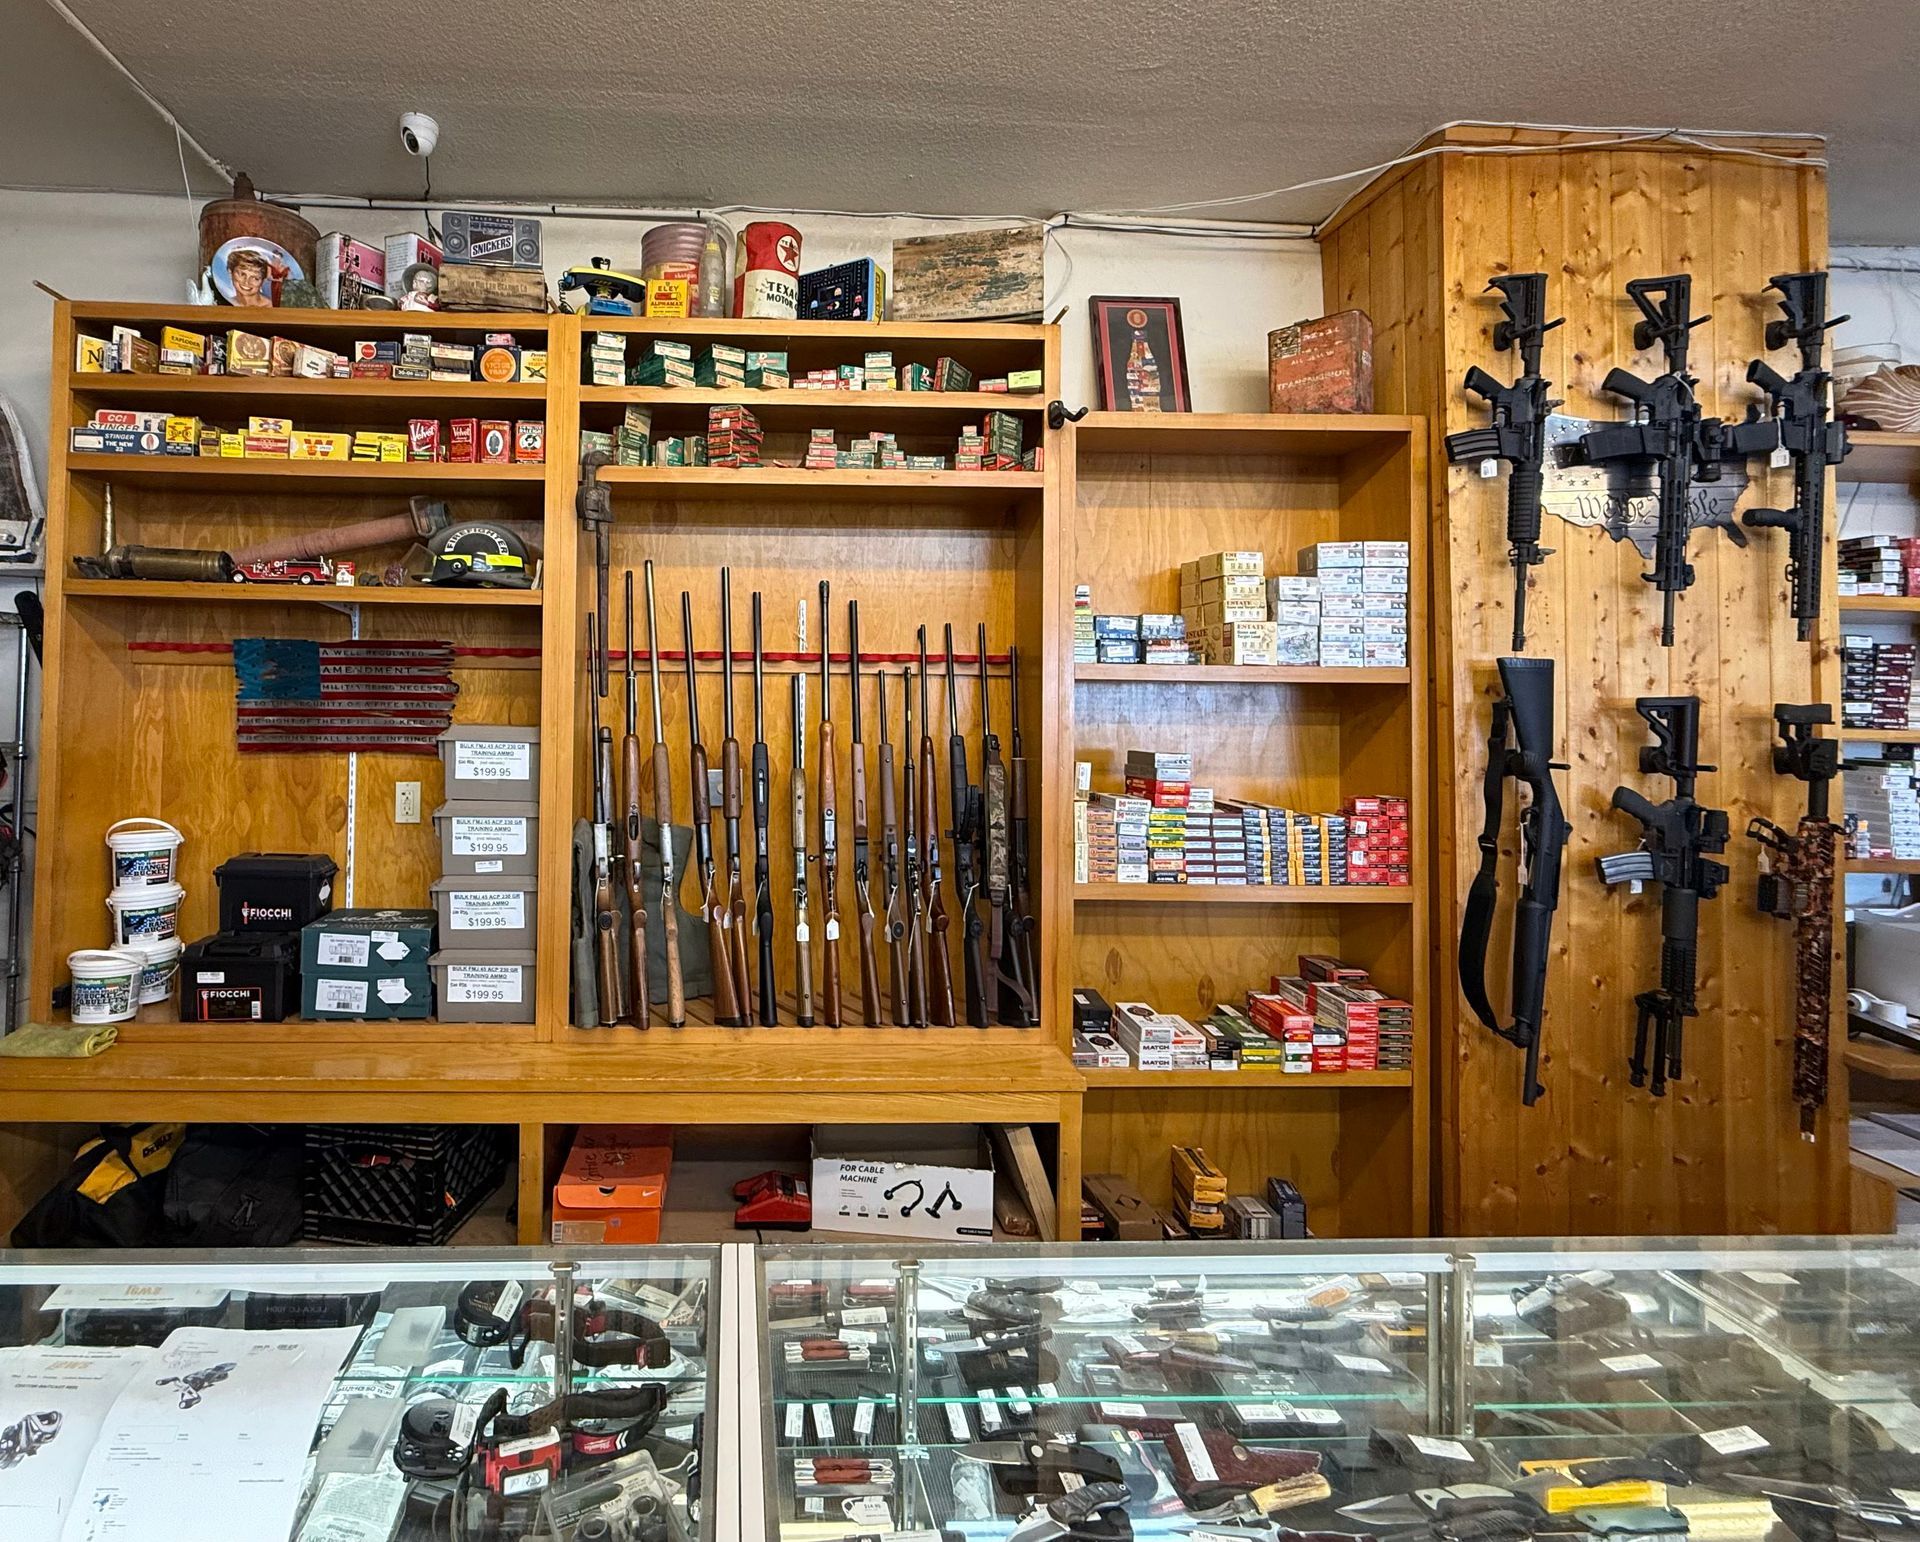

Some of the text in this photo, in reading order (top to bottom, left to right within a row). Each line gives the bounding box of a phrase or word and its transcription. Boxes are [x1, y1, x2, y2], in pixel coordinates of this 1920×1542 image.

[472, 237, 511, 256] SNICKERS
[766, 293, 794, 310] MOTOR
[171, 335, 200, 348] EXPLODER
[107, 414, 128, 422] CCI
[90, 422, 140, 431] STINGER
[410, 422, 435, 442] Velvet
[452, 427, 471, 437] Velvet
[322, 666, 413, 674] AMENDMENT
[473, 767, 511, 777] $199.95
[470, 843, 508, 852] $199.95
[134, 869, 168, 877] BUCKET
[250, 908, 292, 917] FIOCCHI
[468, 917, 506, 927] $199.95
[210, 990, 250, 999] FIOCCHI
[465, 989, 503, 999] $199.95
[840, 1164, 884, 1174] FOR CABLE
[840, 1174, 878, 1184] MACHINE
